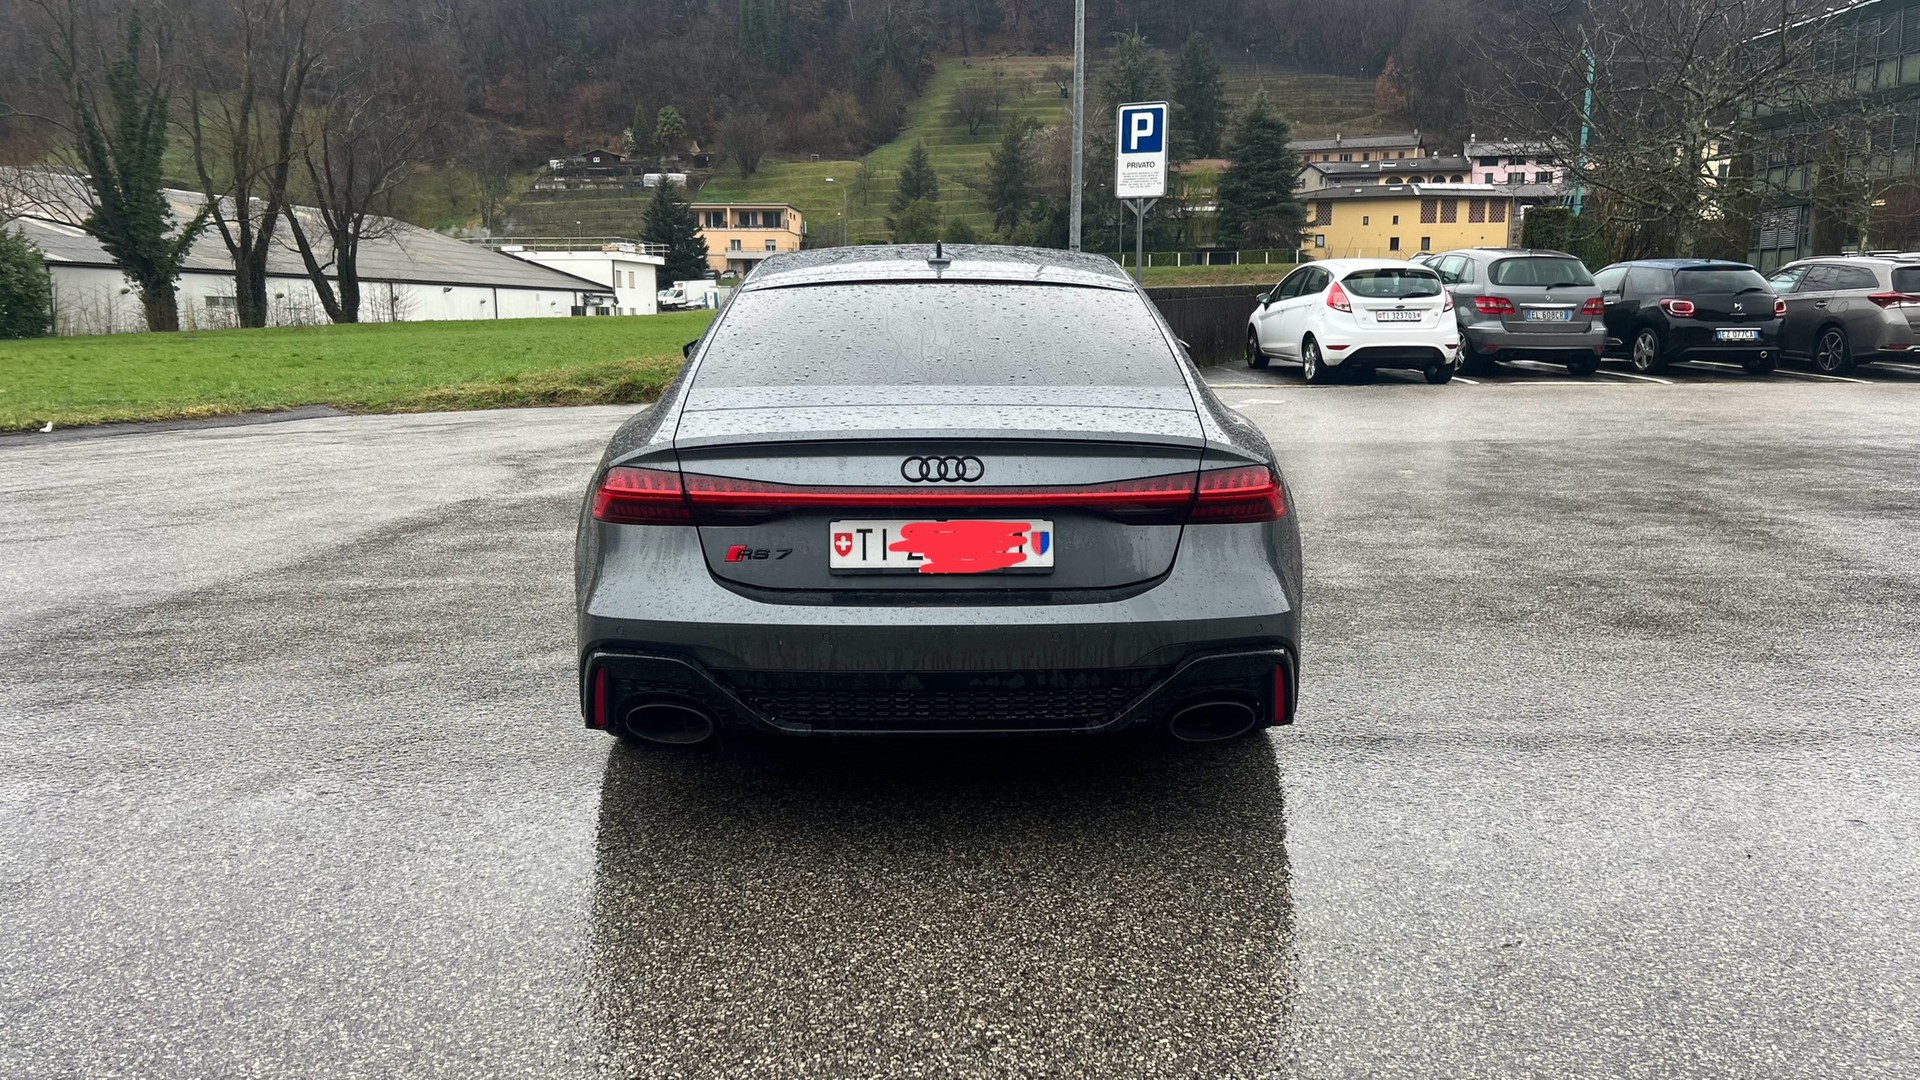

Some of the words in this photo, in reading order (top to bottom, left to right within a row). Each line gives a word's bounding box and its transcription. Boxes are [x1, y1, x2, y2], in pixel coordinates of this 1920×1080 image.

[1130, 112, 1154, 150] P
[1126, 161, 1156, 169] PRIVATO
[1532, 311, 1540, 319] EL
[856, 528, 888, 561] TI
[735, 547, 770, 560] RS
[775, 548, 794, 560] 7
